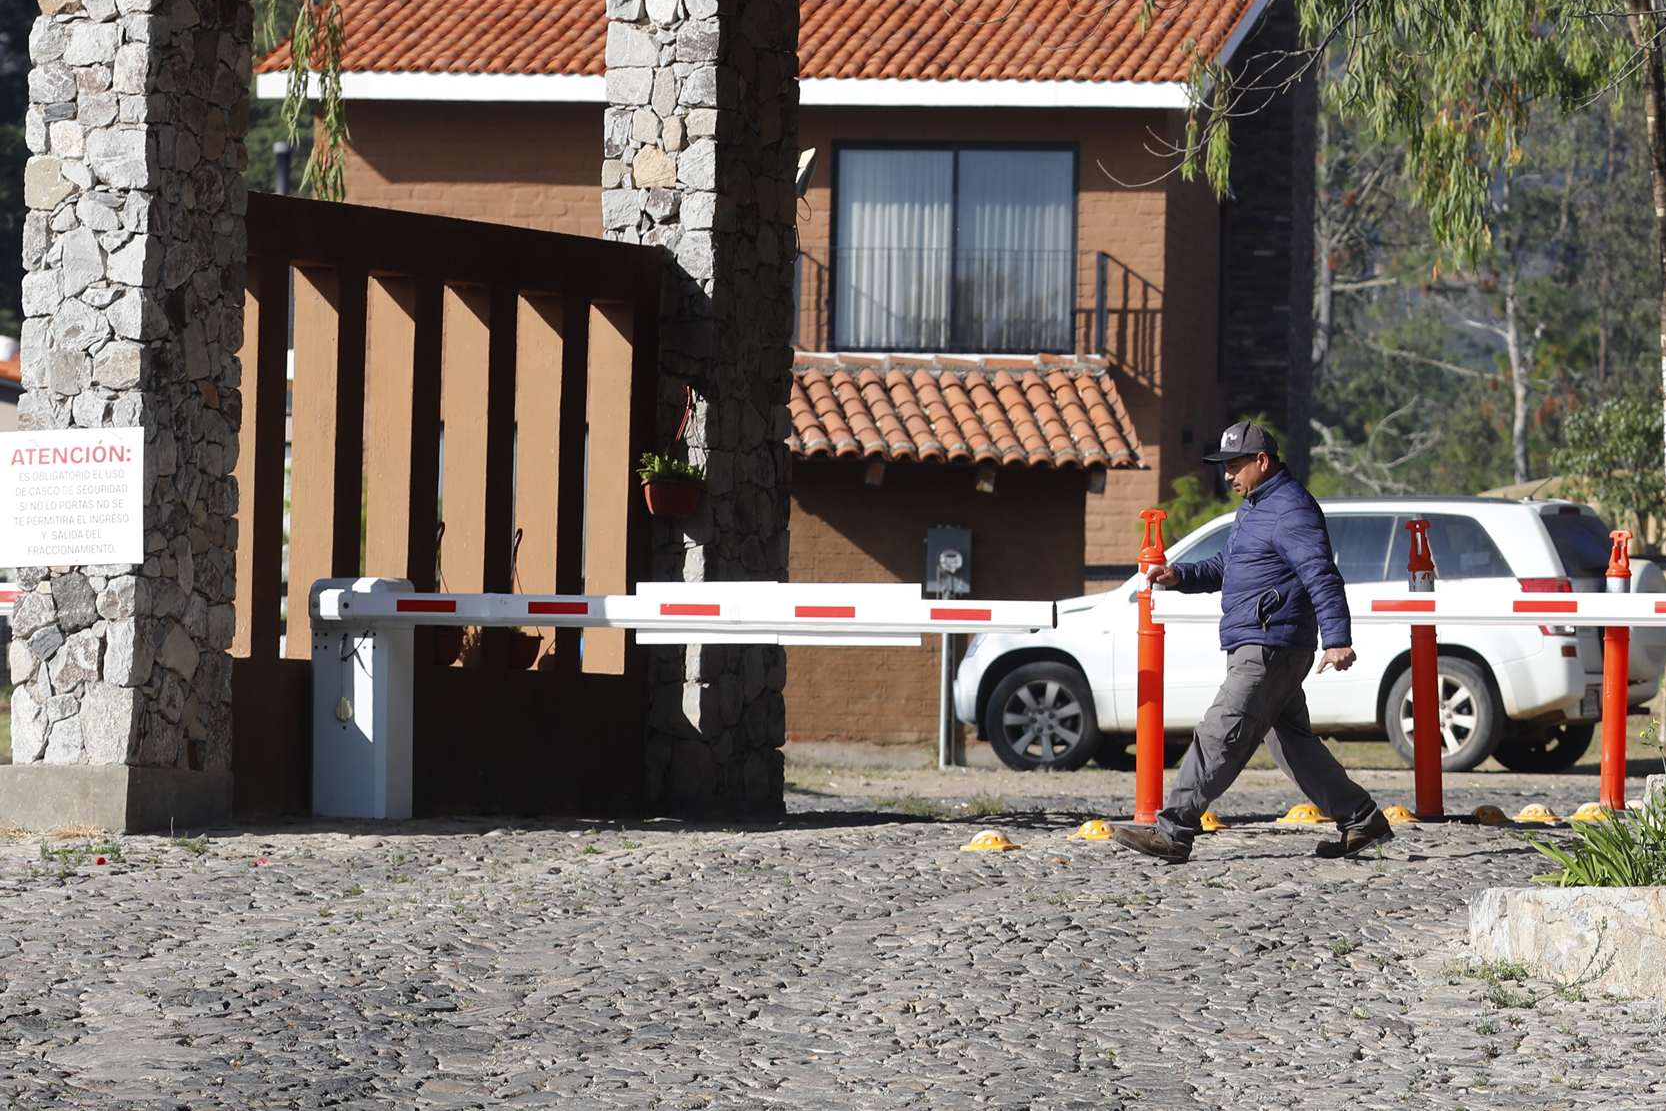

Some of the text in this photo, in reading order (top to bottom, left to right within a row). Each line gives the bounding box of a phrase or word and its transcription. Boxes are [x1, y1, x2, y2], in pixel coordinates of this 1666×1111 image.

[10, 439, 132, 466] ATENCIÓN:
[19, 469, 125, 482] ES OBLIGATORIO EL USO
[15, 484, 128, 496] DE CASCO DE SEGURIDAD
[19, 499, 123, 511] SI NO LO PORTAS NO SE
[14, 514, 129, 526] TE PERMITIRA EL INGRESO
[41, 530, 102, 540] Y SALIDA DEL
[28, 544, 116, 555] FRACCIONAMIENTO.
